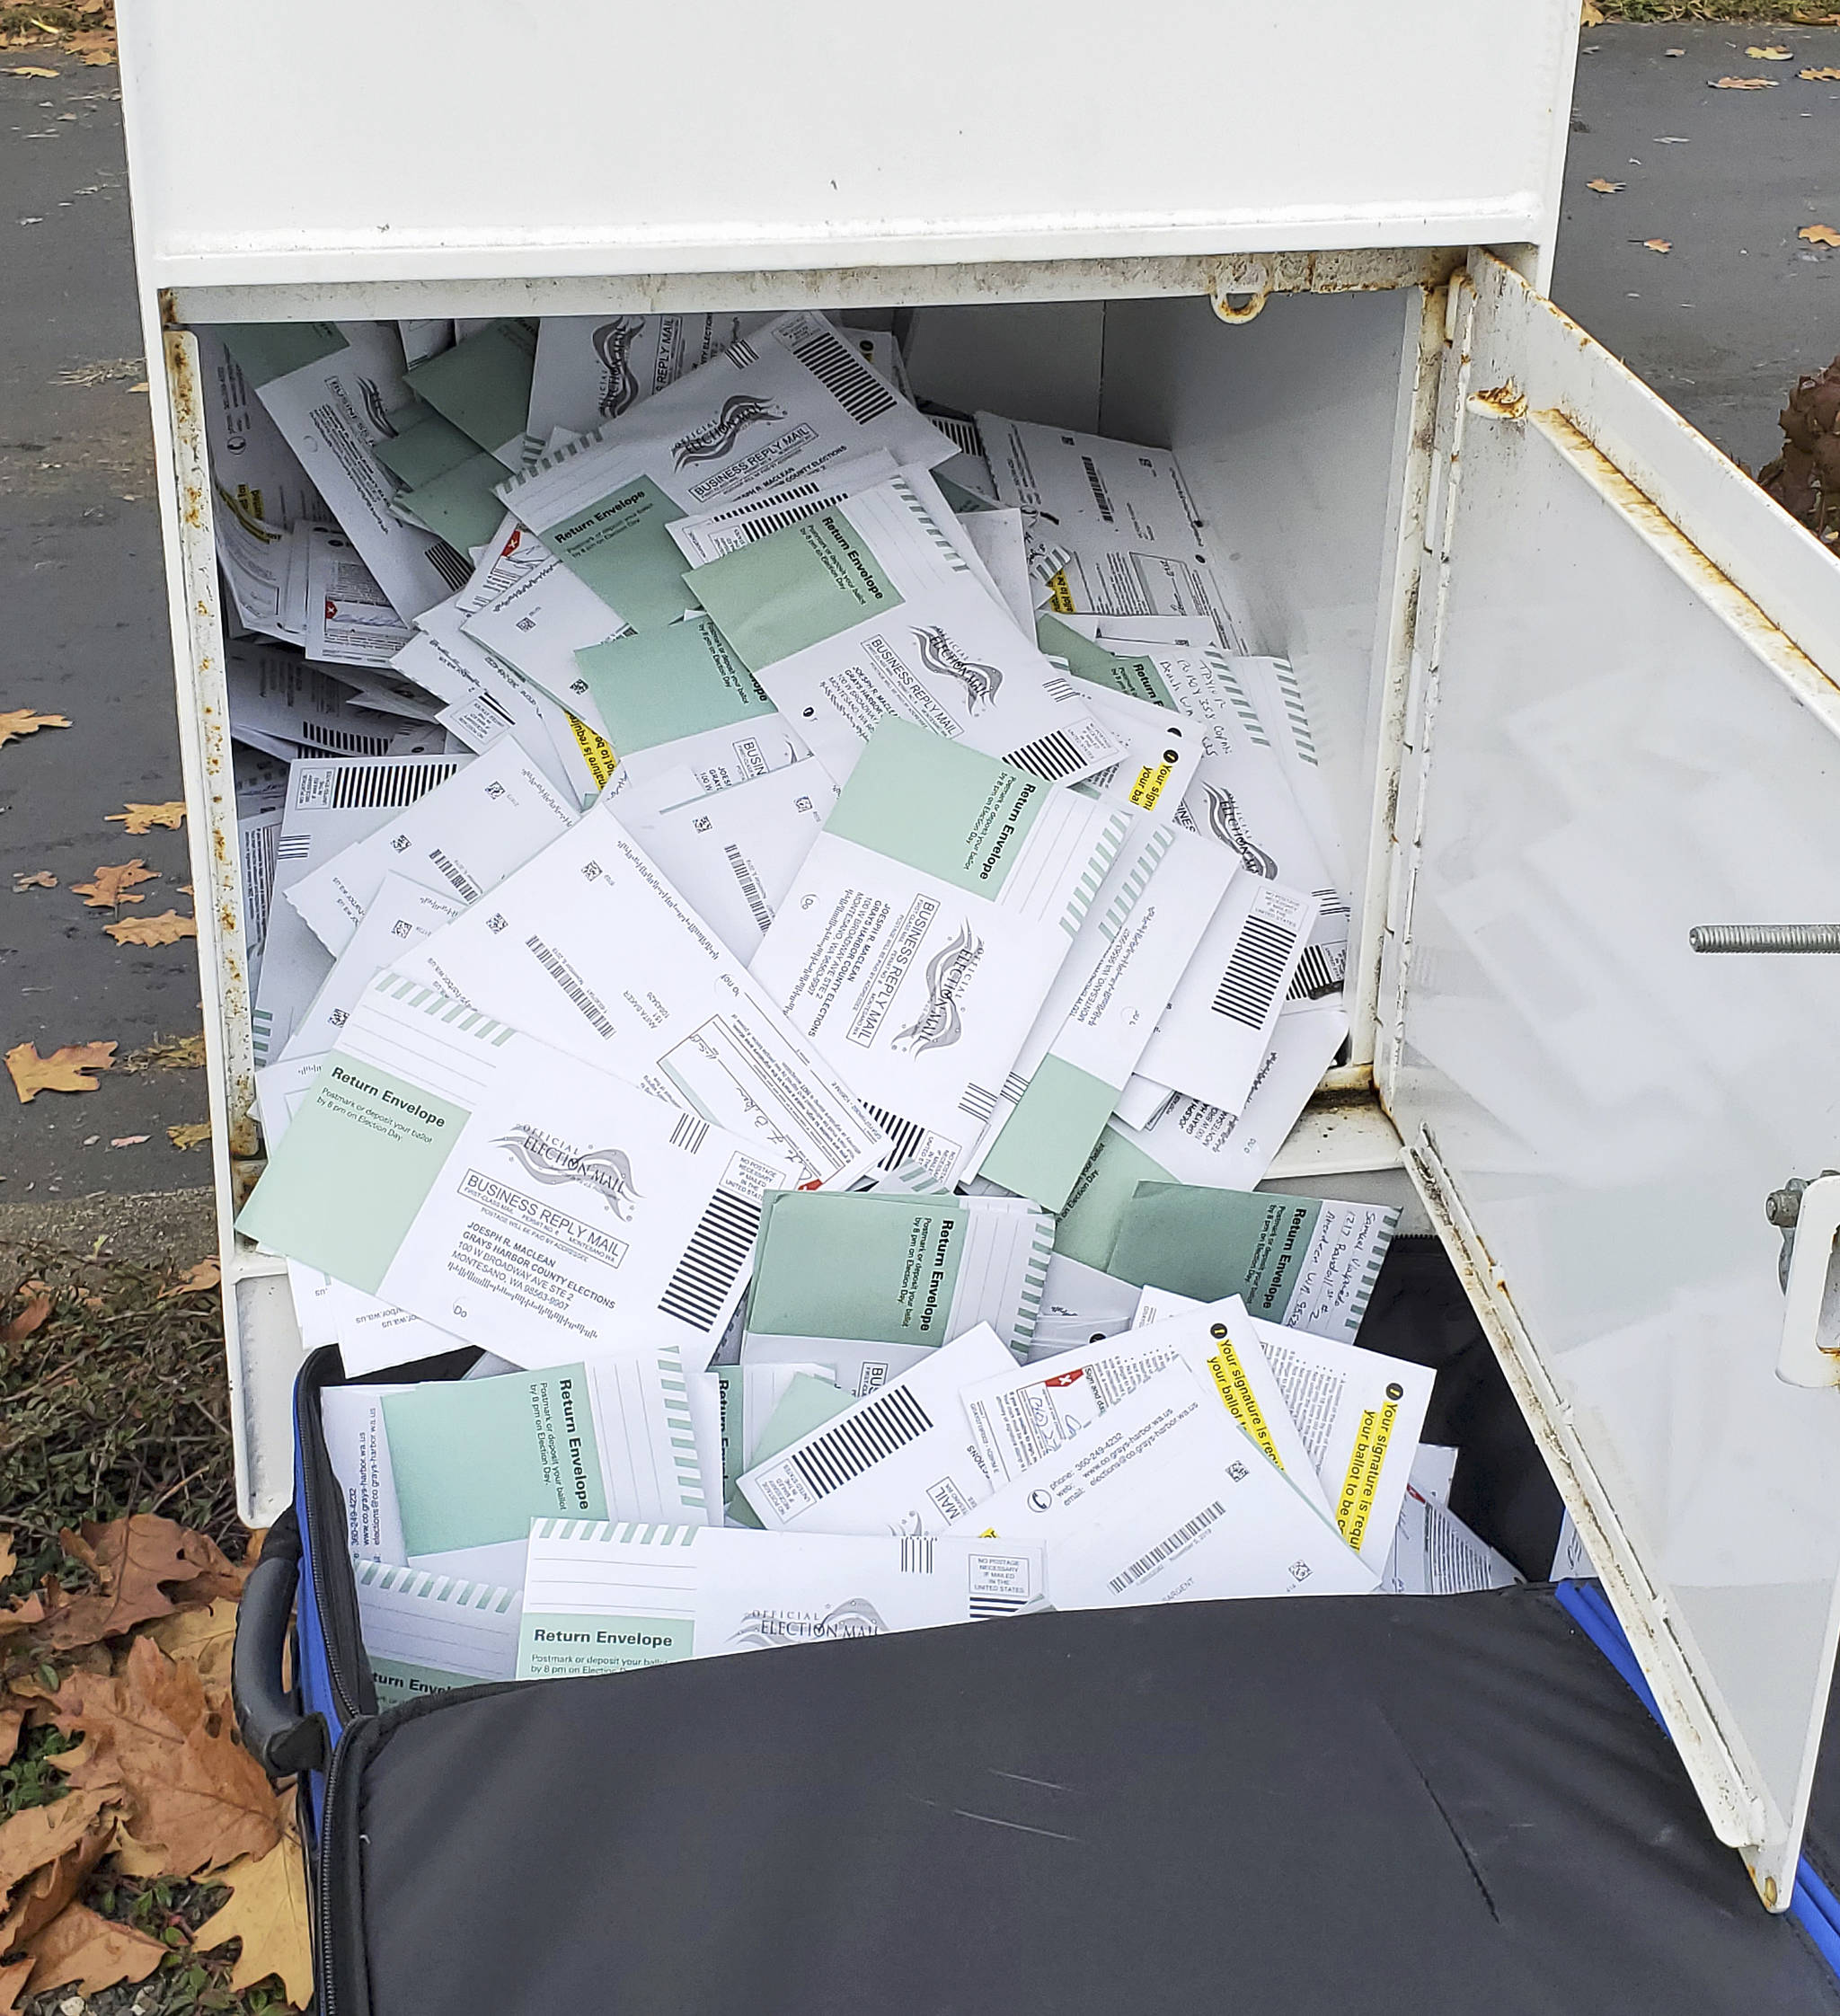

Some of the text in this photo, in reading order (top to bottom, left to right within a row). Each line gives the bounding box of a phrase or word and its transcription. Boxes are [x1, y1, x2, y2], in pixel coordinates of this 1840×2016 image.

[656, 317, 674, 385] REPLY MAIL
[694, 428, 809, 496] BUSINESS REPLY MAIL
[784, 445, 847, 482] COUNTY ELECTIONS
[553, 518, 595, 544] Return
[593, 491, 645, 521] Envelope
[821, 516, 882, 598] Return Envelope
[928, 632, 969, 676] ELECTION
[844, 668, 862, 690] GRAYS
[868, 638, 956, 735] BUSINESS REPLY MAIL
[1132, 663, 1156, 698] Return
[598, 747, 610, 759] to
[1154, 762, 1172, 787] Your
[1135, 765, 1153, 790] your
[962, 775, 1016, 870] Postmark deposit your ballot
[972, 805, 991, 831] Election
[979, 783, 1036, 880] Return Envelope
[801, 897, 814, 910] Do
[832, 891, 863, 940] MONTESANO,
[818, 897, 872, 994] 100 W BROADWAY AVE STE
[846, 903, 890, 982] JOESPH R. MACLEAN
[808, 899, 881, 1037] GRAYS HARBOR COUNTY ELECTIONS
[857, 901, 934, 1039] BUSINESS REPLY MAIL
[954, 946, 985, 999] OFFICIAL
[622, 989, 658, 1030] ANITA BAKER
[916, 947, 973, 1044] ELECTION MAIL
[315, 1095, 387, 1133] by pm Election
[321, 1086, 432, 1143] Postmark or deposit your ballot
[331, 1066, 445, 1127] Return Envelope
[1178, 1101, 1197, 1128] JOESPH
[521, 1123, 580, 1155] OFFICIAL
[522, 1135, 626, 1194] ELECTION MAIL
[467, 1174, 618, 1257] BUSINESS REPLY MAIL
[1065, 1180, 1090, 1210] Election
[466, 1221, 556, 1268] JOESPH R. MACLEAN
[917, 1216, 932, 1252] Postmark
[1340, 1210, 1356, 1236] 1217
[1353, 1210, 1376, 1251] Samuel
[451, 1250, 523, 1290] MONTESANO, WA
[457, 1240, 574, 1302] 100 W BROADWAY AVE STE 2
[462, 1230, 615, 1308] GRAYS HARBOR COUNTY ELECTIONS
[901, 1259, 915, 1288] Election
[909, 1261, 922, 1290] deposit
[916, 1252, 923, 1262] or
[919, 1219, 954, 1331] Return Envelope
[1262, 1207, 1306, 1308] Return Envelope
[453, 1304, 467, 1318] Do
[907, 1290, 916, 1307] your
[1082, 1366, 1101, 1400] Sign and
[1206, 1355, 1243, 1419] your ballot
[1218, 1339, 1269, 1439] Your signature is
[528, 1384, 551, 1485] by pm on Election Day.
[539, 1382, 567, 1510] Postmark or deposit your ballot
[559, 1378, 588, 1509] Return Envelope
[1358, 1401, 1398, 1513] Your signature is
[1049, 1432, 1123, 1490] phone: 360-249-4232
[1339, 1409, 1376, 1517] your ballot to be
[934, 1486, 960, 1519] MAIL
[1056, 1481, 1075, 1498] web:
[1063, 1488, 1086, 1507] email:
[349, 1488, 359, 1545] 360-249-4232
[751, 1609, 818, 1621] OFFICIAL
[760, 1620, 837, 1638] ELECTION
[531, 1653, 641, 1667] Postmark or deposit your
[534, 1628, 672, 1648] Return Envelope
[530, 1664, 542, 1674] by
[551, 1666, 566, 1675] pm
